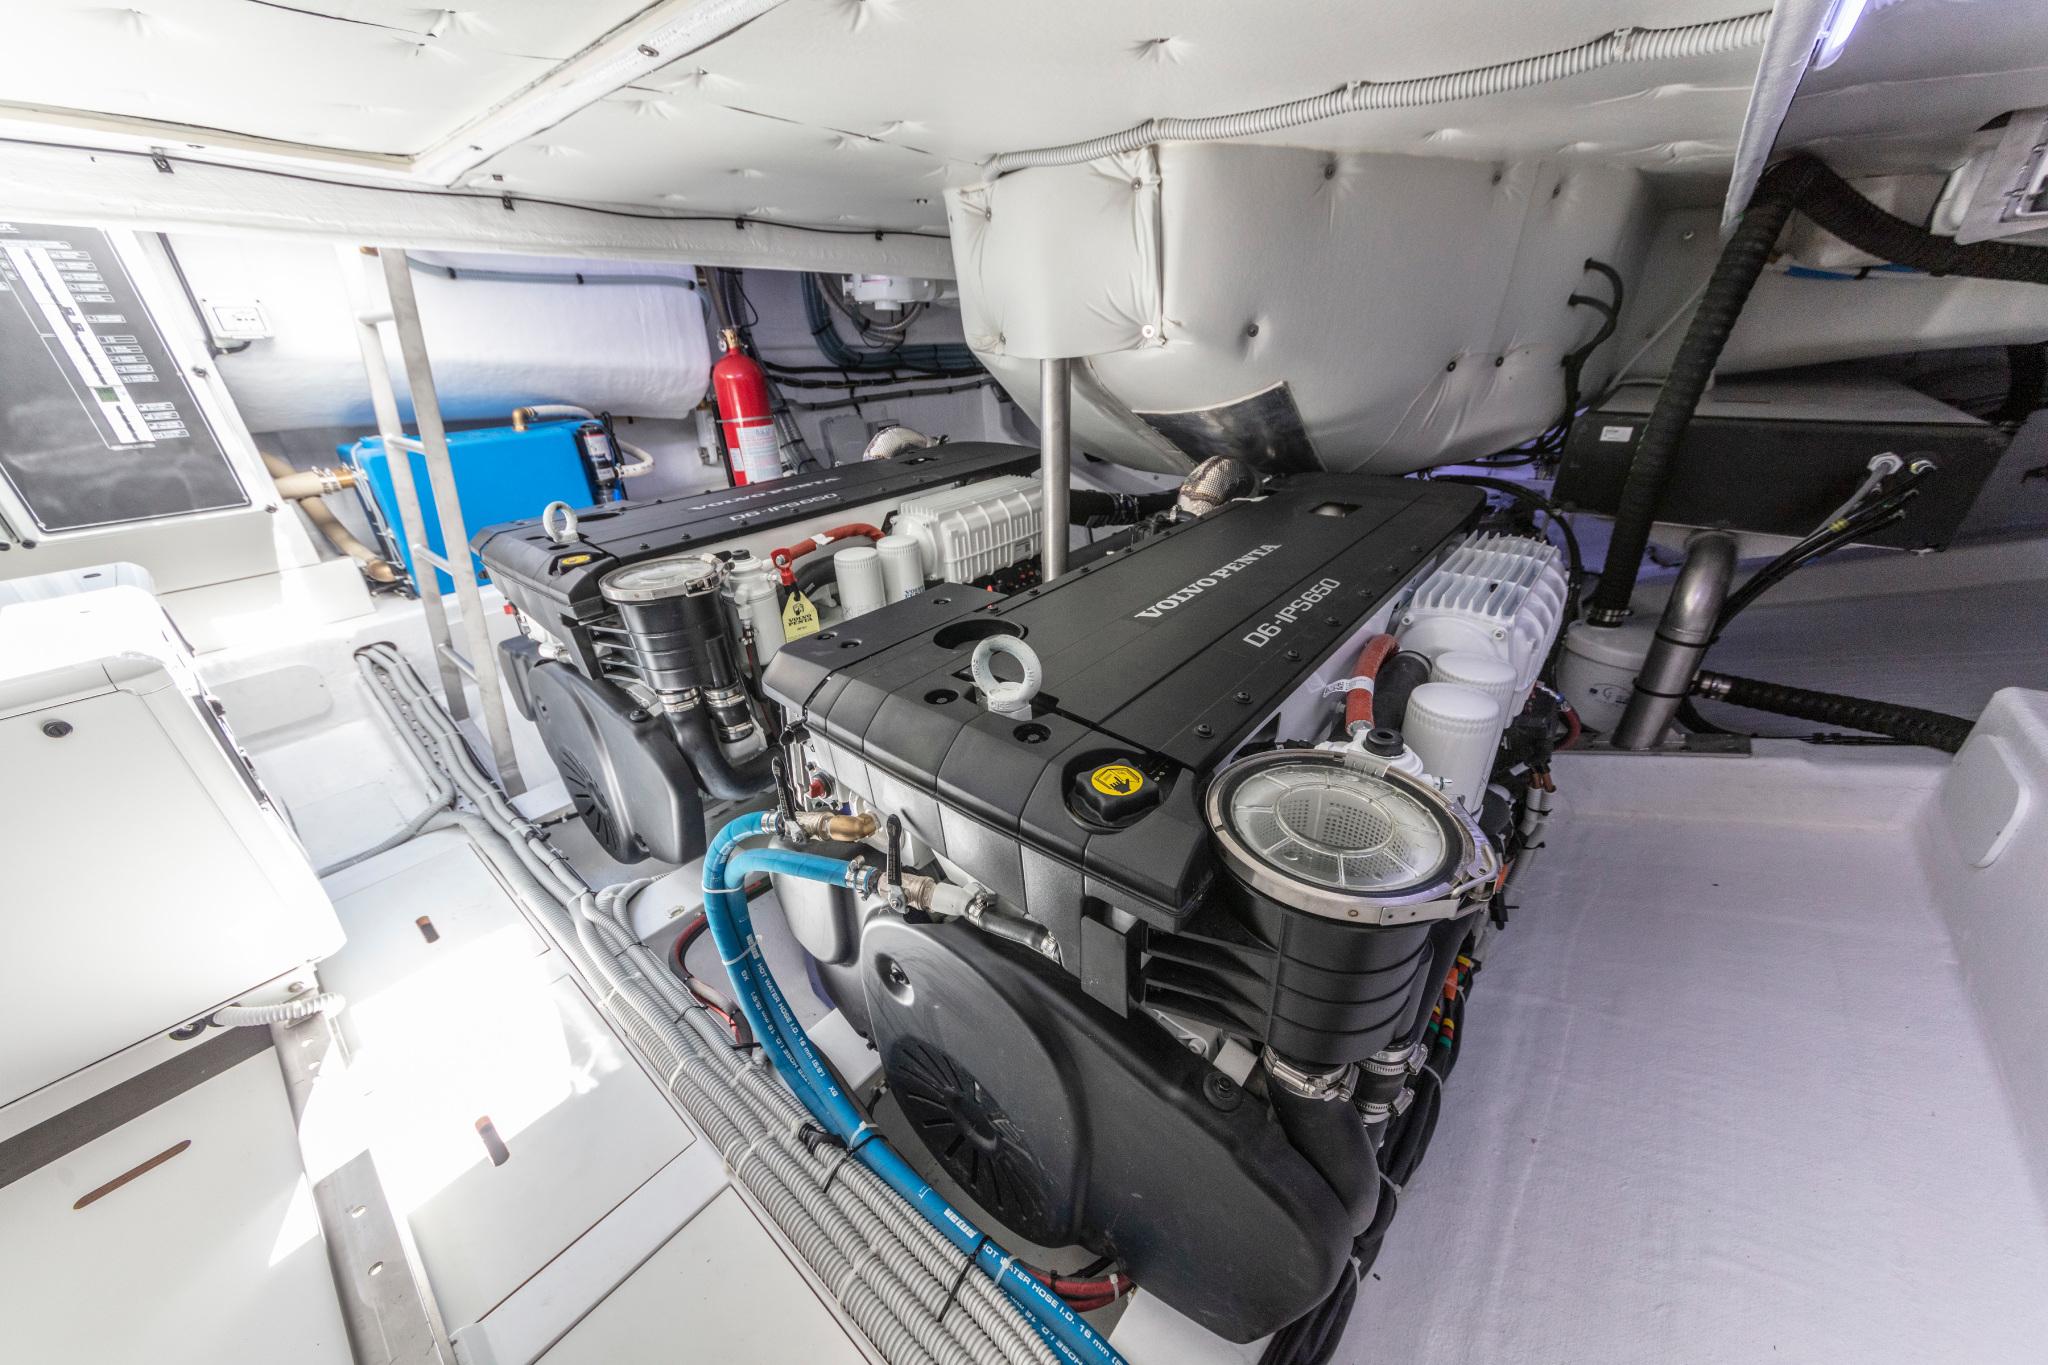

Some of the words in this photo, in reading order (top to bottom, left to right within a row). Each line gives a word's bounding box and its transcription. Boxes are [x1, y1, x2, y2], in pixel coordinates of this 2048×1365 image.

[687, 493, 766, 511] VOLVO
[1133, 577, 1218, 619] VOLVO
[1209, 544, 1283, 579] PENTA
[788, 614, 812, 623] VOLVO
[1242, 577, 1341, 648] D6-IPS650
[756, 962, 768, 978] HOT
[764, 978, 780, 1004] WATER
[778, 1003, 793, 1024] HOSE
[798, 1036, 807, 1047] 16
[803, 1047, 814, 1060] mm
[943, 1207, 978, 1239] vetus
[1031, 1282, 1059, 1309] HOSE
[1059, 1306, 1075, 1325] I.D.
[1079, 1324, 1093, 1340] 16
[1092, 1338, 1110, 1358] mm
[1024, 1309, 1037, 1323] 16
[1055, 1339, 1084, 1365] HOSE
